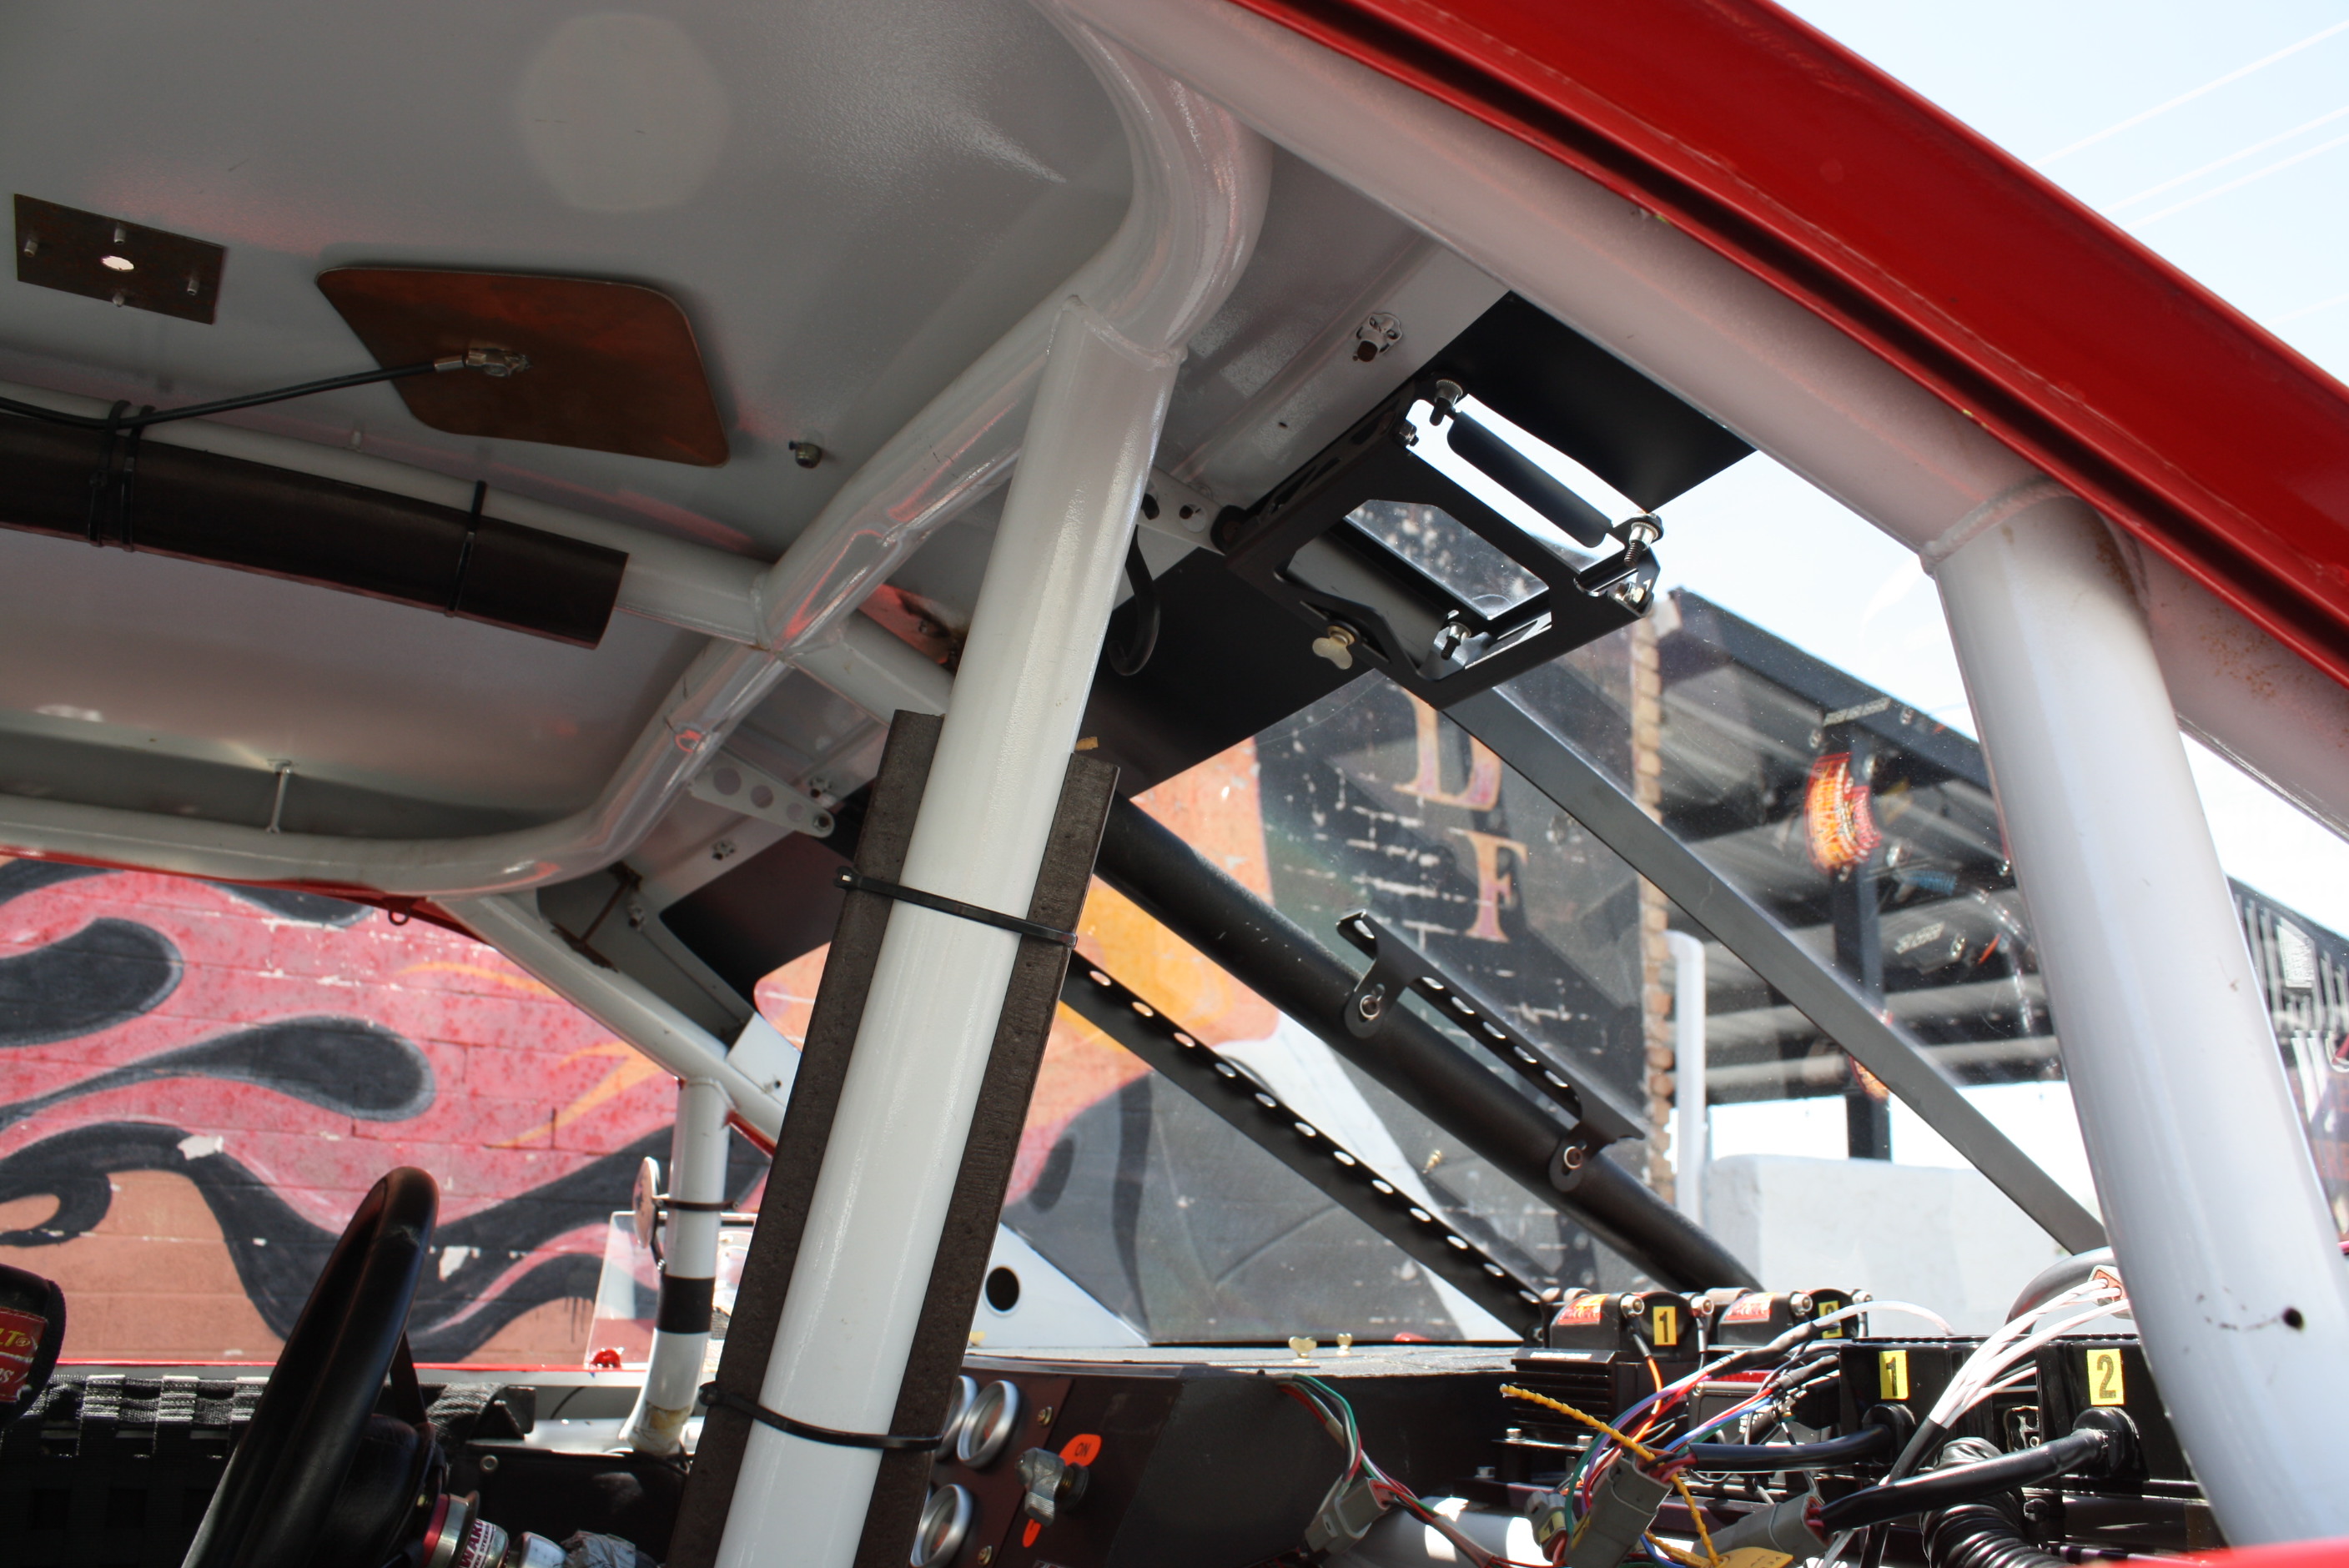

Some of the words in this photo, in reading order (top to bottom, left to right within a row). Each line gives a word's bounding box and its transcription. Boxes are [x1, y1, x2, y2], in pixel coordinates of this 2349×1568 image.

[1659, 1310, 1669, 1344] 1
[1885, 1356, 1899, 1397] 1
[2096, 1354, 2117, 1399] 2
[1074, 1442, 1092, 1457] ON
